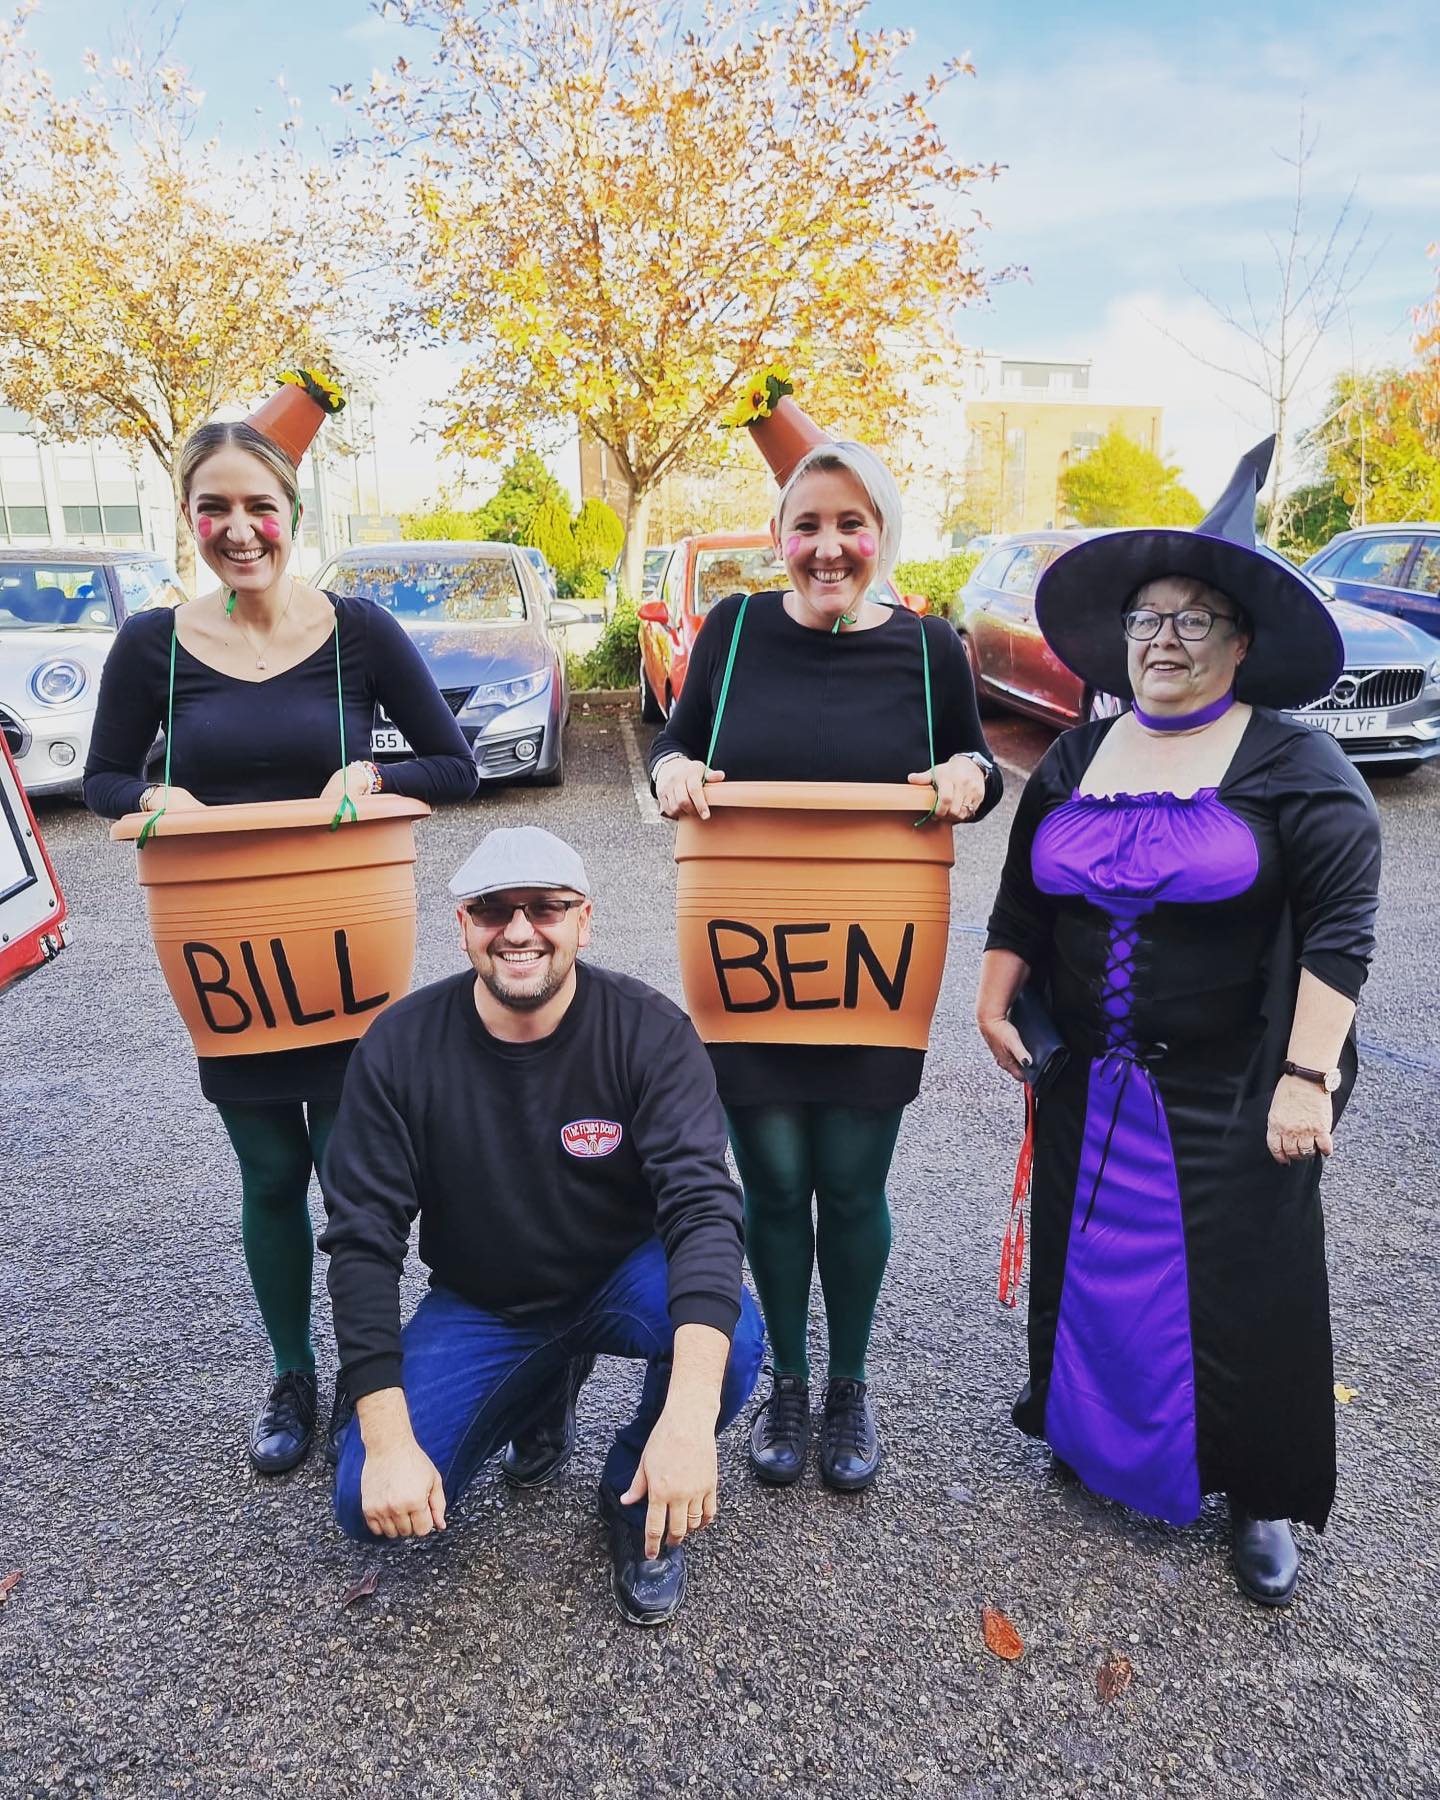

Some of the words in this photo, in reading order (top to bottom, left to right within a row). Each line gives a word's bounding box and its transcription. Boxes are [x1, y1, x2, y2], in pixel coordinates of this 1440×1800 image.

[1345, 715, 1377, 732] LYF
[182, 928, 390, 1034] BILL
[707, 919, 915, 1013] BEN
